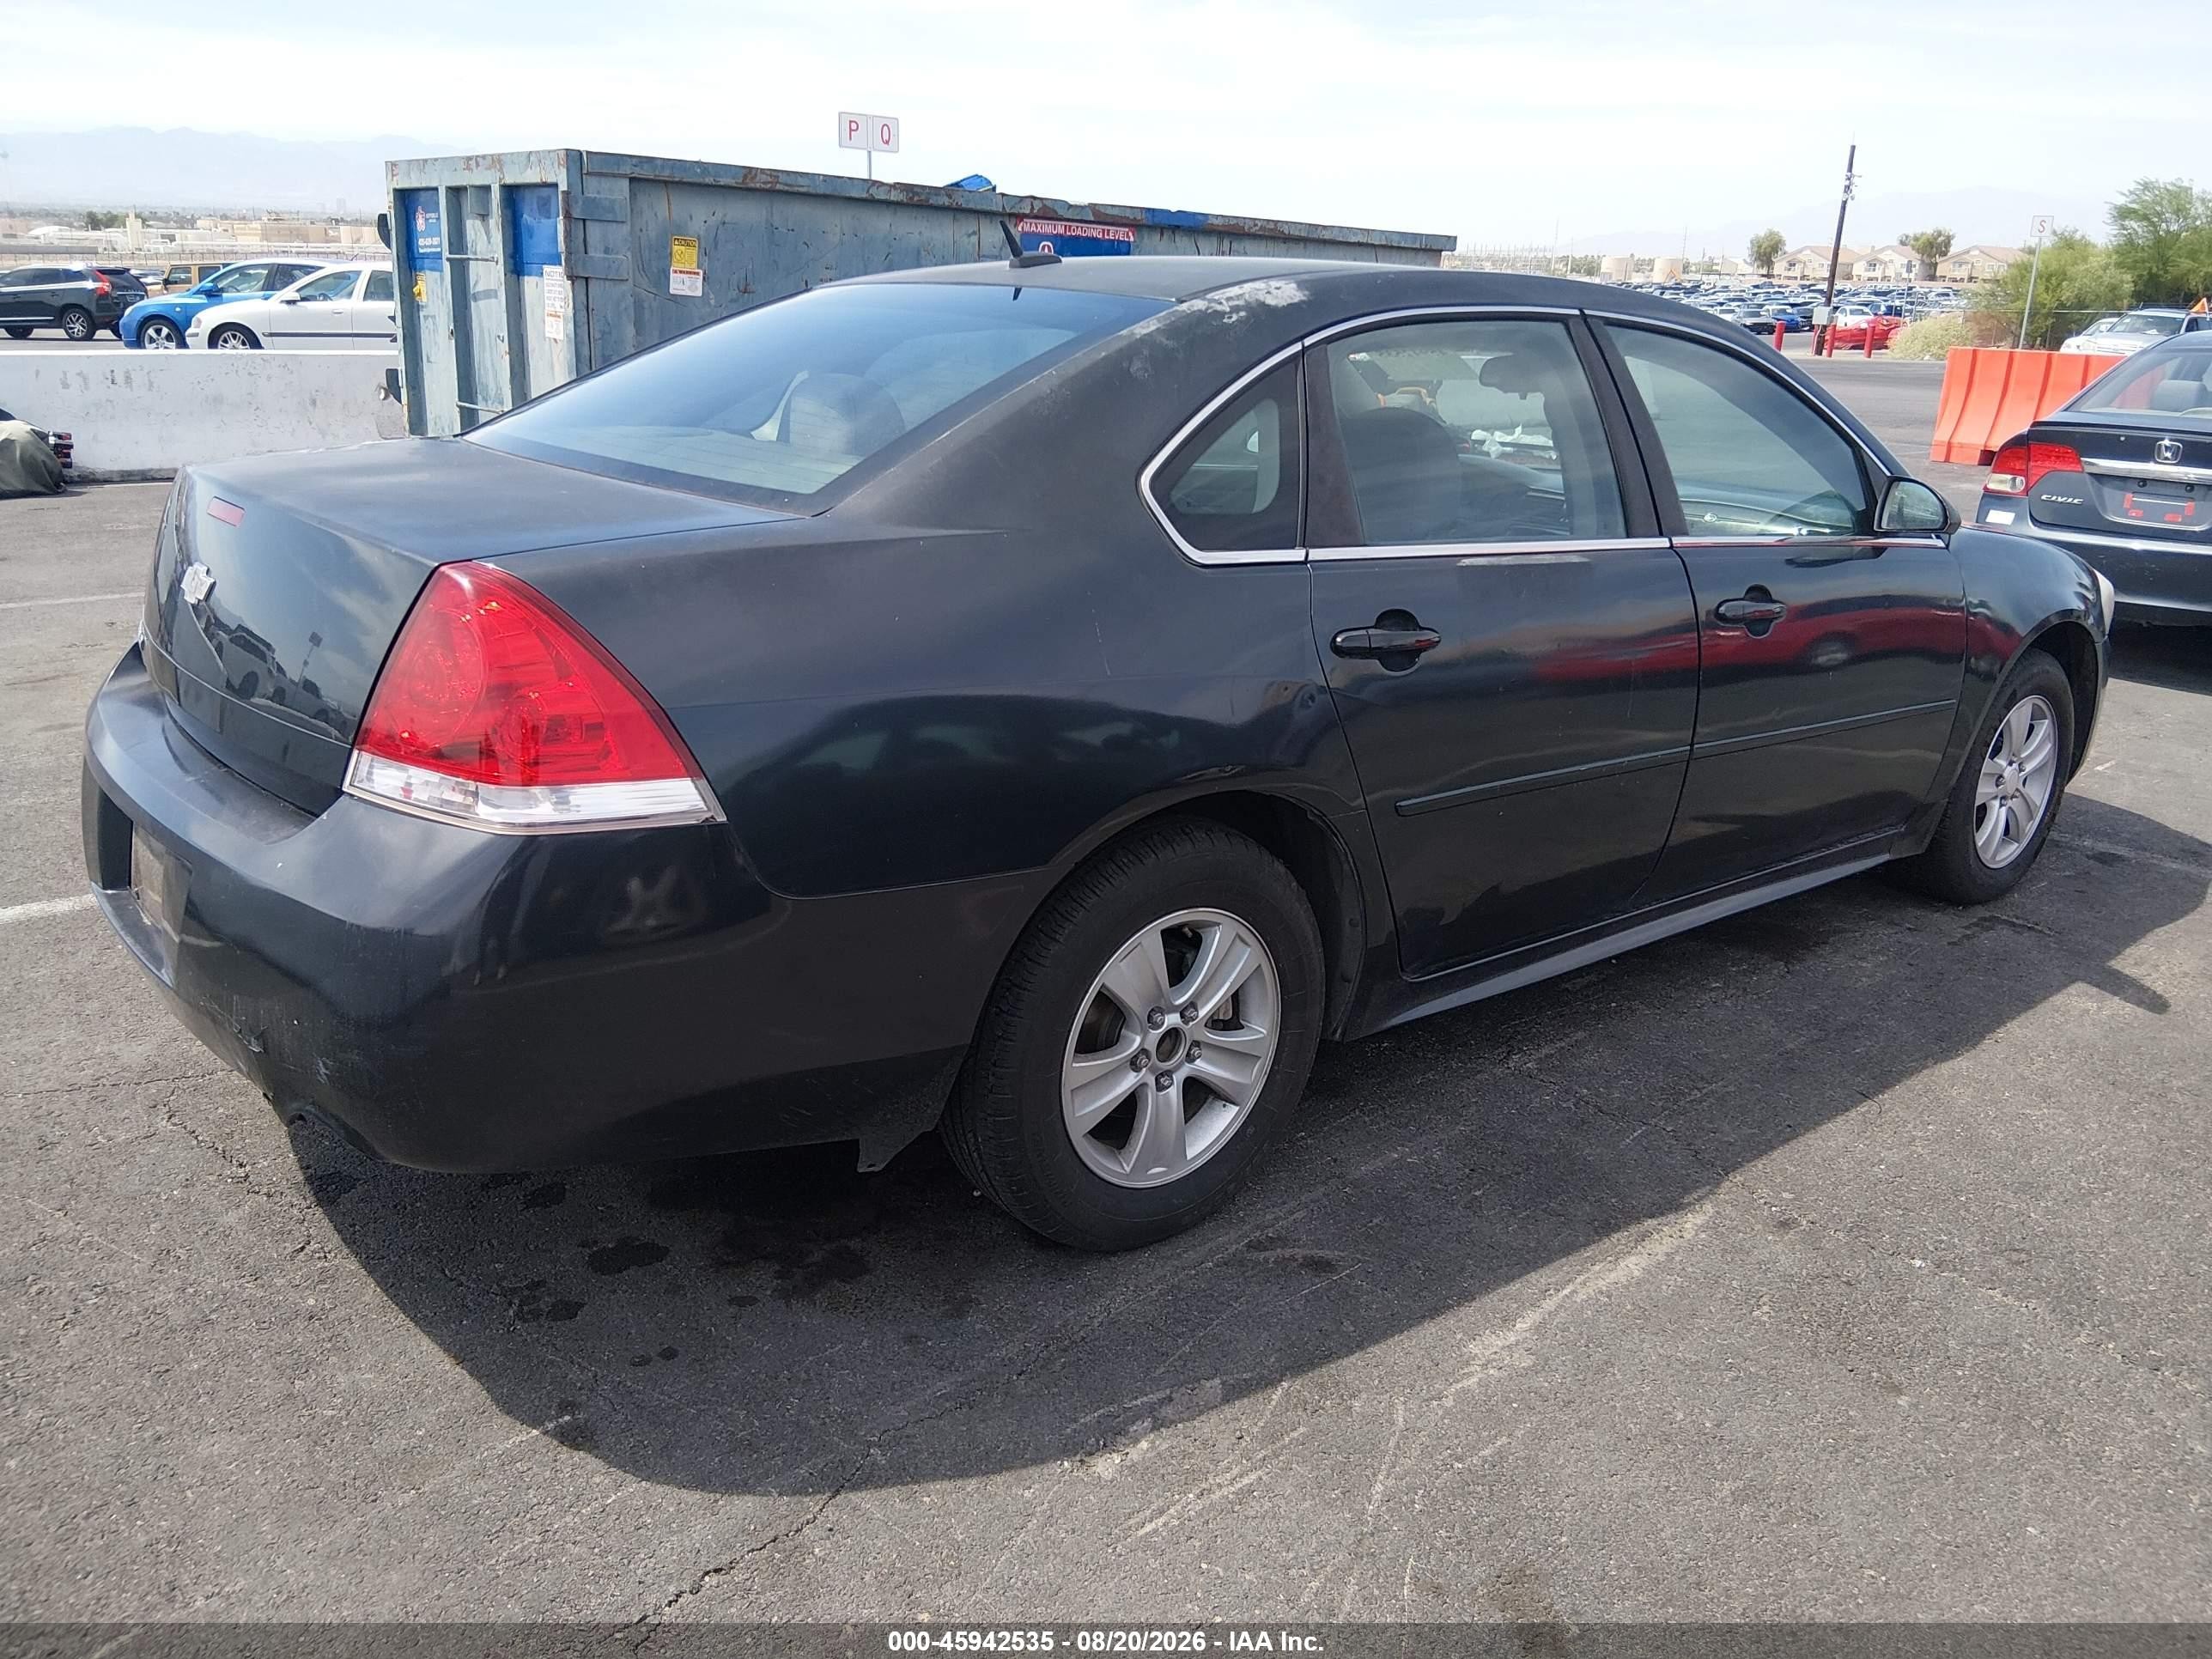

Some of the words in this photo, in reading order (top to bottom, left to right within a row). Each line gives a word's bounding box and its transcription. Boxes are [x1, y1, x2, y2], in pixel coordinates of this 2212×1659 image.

[848, 119, 860, 142] P
[881, 123, 890, 146] Q
[1023, 221, 1065, 234] MAXIMUM
[1066, 223, 1102, 239] LOADING
[1104, 228, 1130, 241] LEVEL
[2038, 219, 2046, 234] S
[2040, 495, 2084, 504] CIVIC
